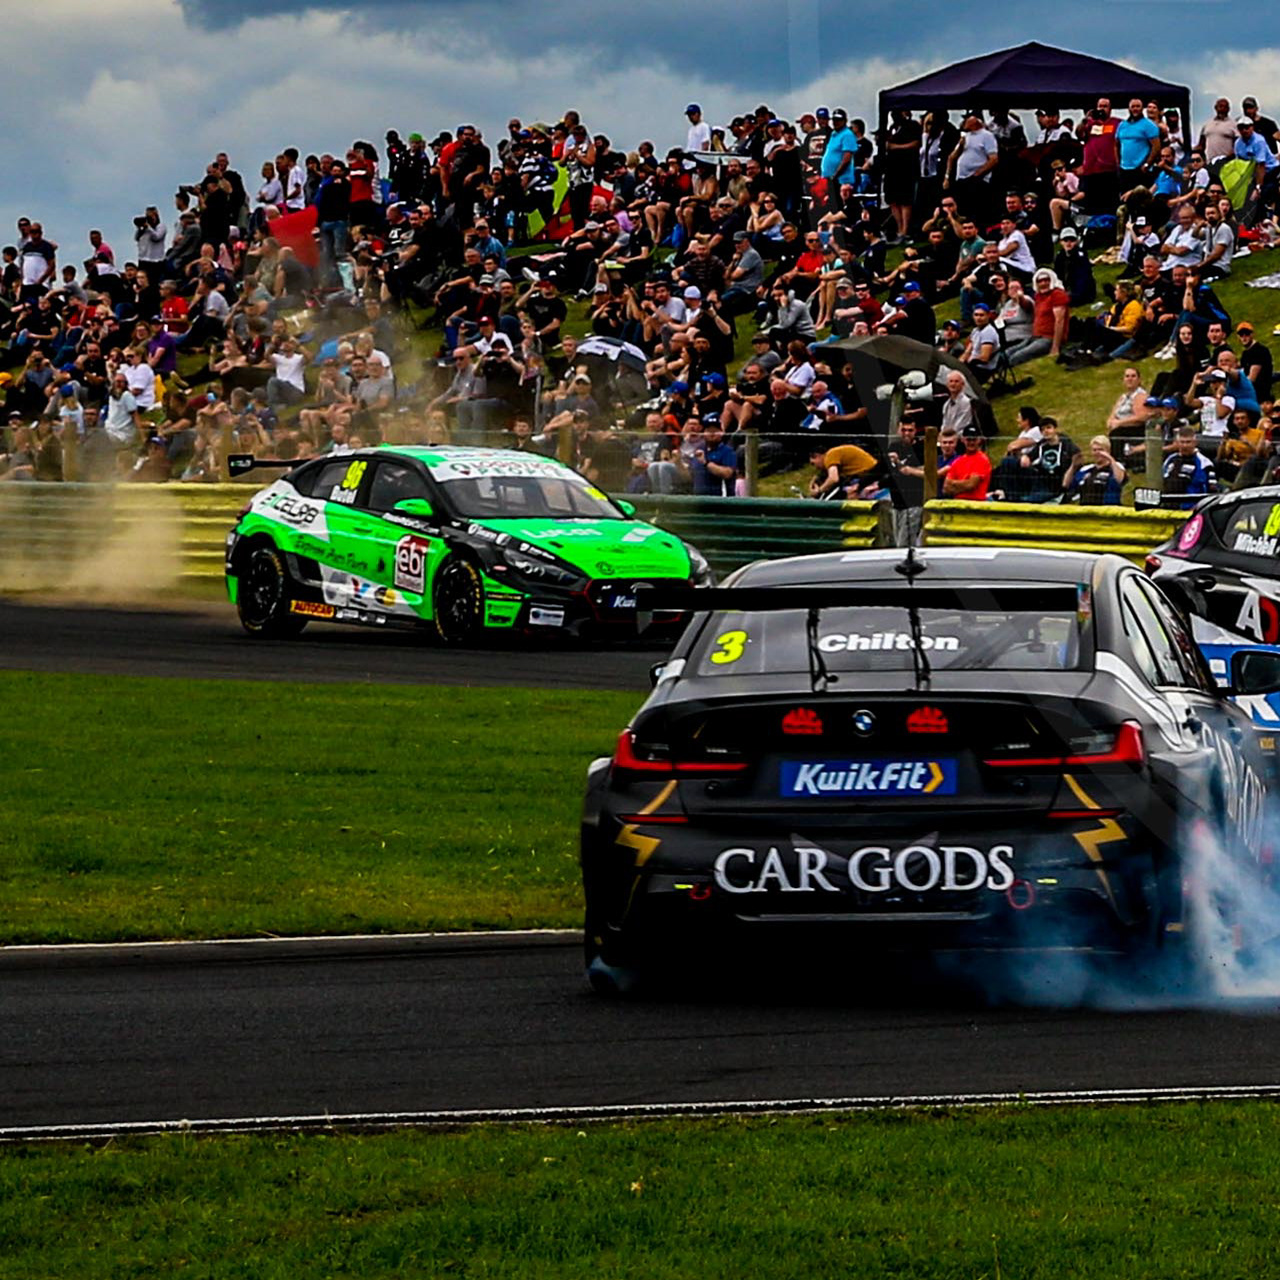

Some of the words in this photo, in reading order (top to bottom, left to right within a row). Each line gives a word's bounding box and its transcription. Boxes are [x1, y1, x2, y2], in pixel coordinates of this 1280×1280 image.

[342, 460, 368, 490] 96
[710, 630, 748, 664] 3
[817, 633, 960, 653] Chilton
[714, 846, 841, 894] CAR
[848, 845, 1015, 893] GODS
